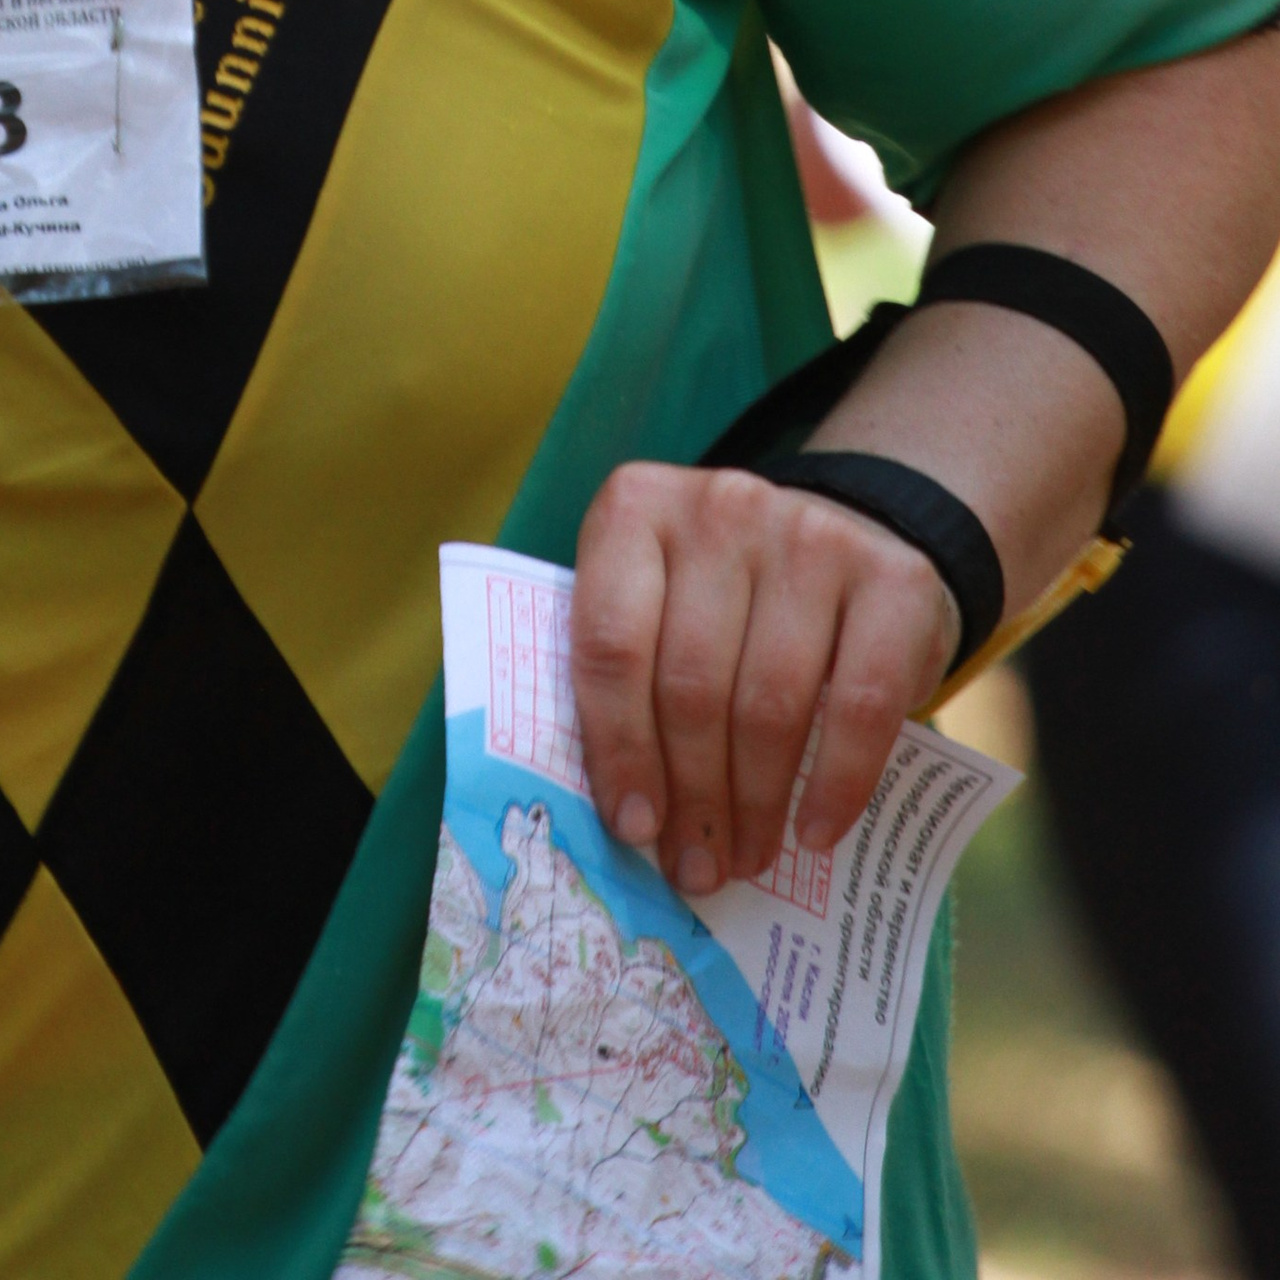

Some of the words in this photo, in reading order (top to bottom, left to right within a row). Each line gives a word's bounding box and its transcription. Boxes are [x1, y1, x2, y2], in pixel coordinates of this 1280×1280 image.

[13, 194, 69, 209] Ольга
[895, 742, 920, 767] по
[843, 767, 901, 909] спортивному
[874, 760, 952, 889] Челябинской
[906, 774, 980, 877] Чемпионат
[858, 892, 883, 982] области
[899, 878, 913, 896] и
[810, 911, 854, 1098] ориентированию
[875, 897, 908, 1026] первенство
